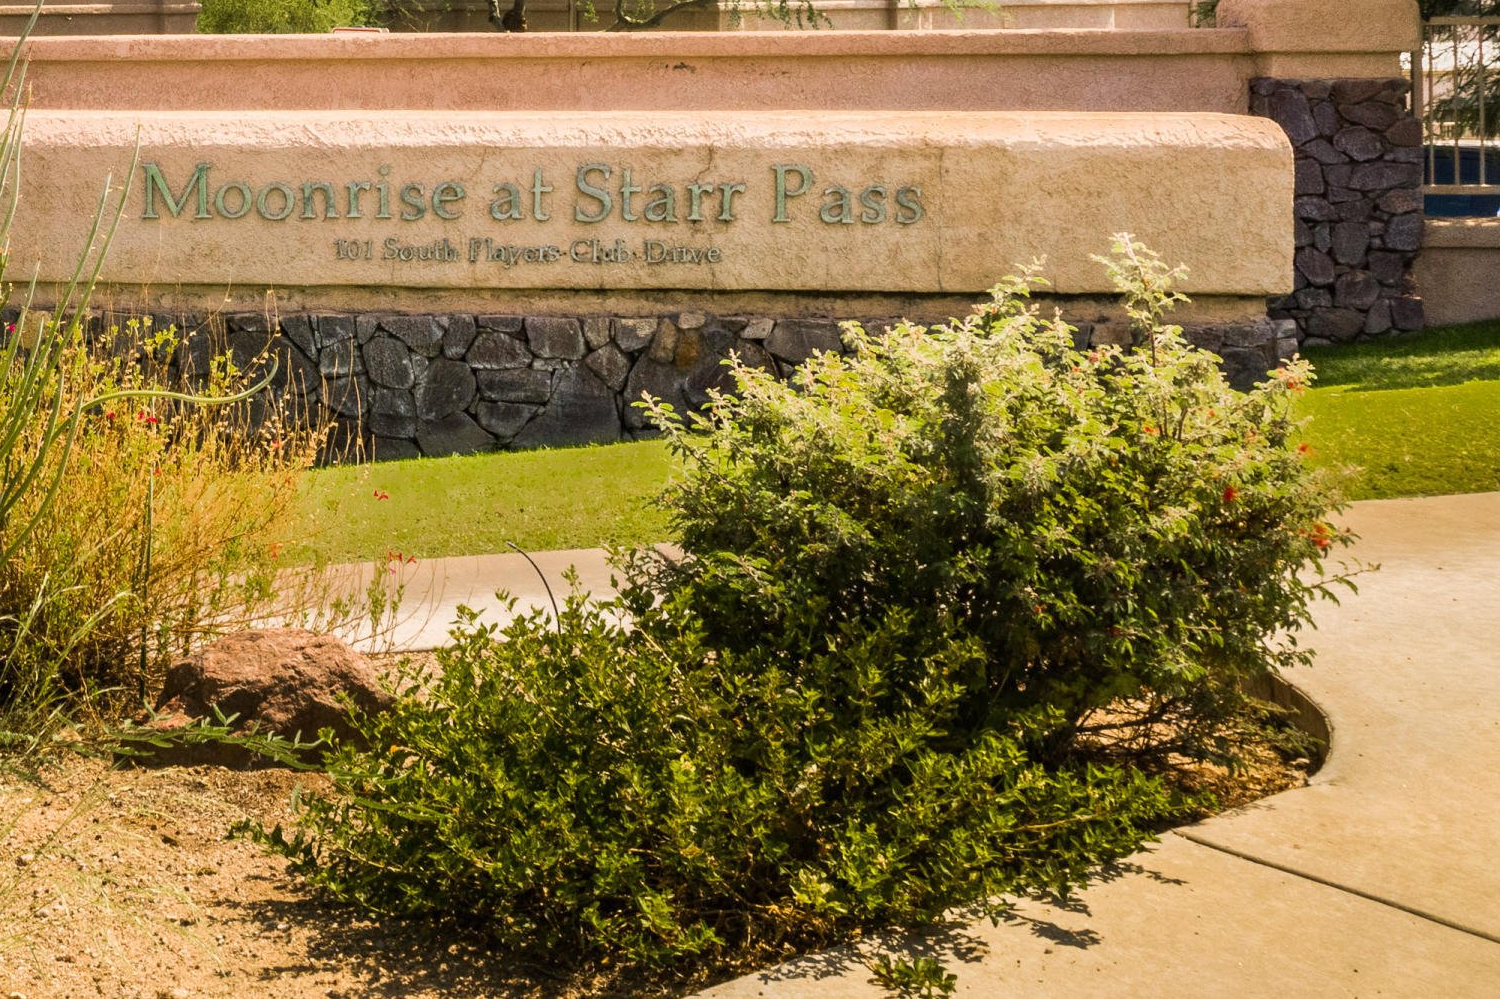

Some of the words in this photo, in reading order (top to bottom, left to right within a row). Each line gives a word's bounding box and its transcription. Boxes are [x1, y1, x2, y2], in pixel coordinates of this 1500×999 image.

[140, 162, 467, 221] Moonrise
[490, 166, 554, 222] at
[574, 162, 747, 224] Starr
[770, 163, 924, 225] Pass
[335, 238, 373, 260] 101
[383, 236, 458, 263] South
[467, 237, 560, 269] Players
[570, 238, 631, 264] Club
[643, 239, 722, 266] Drive
